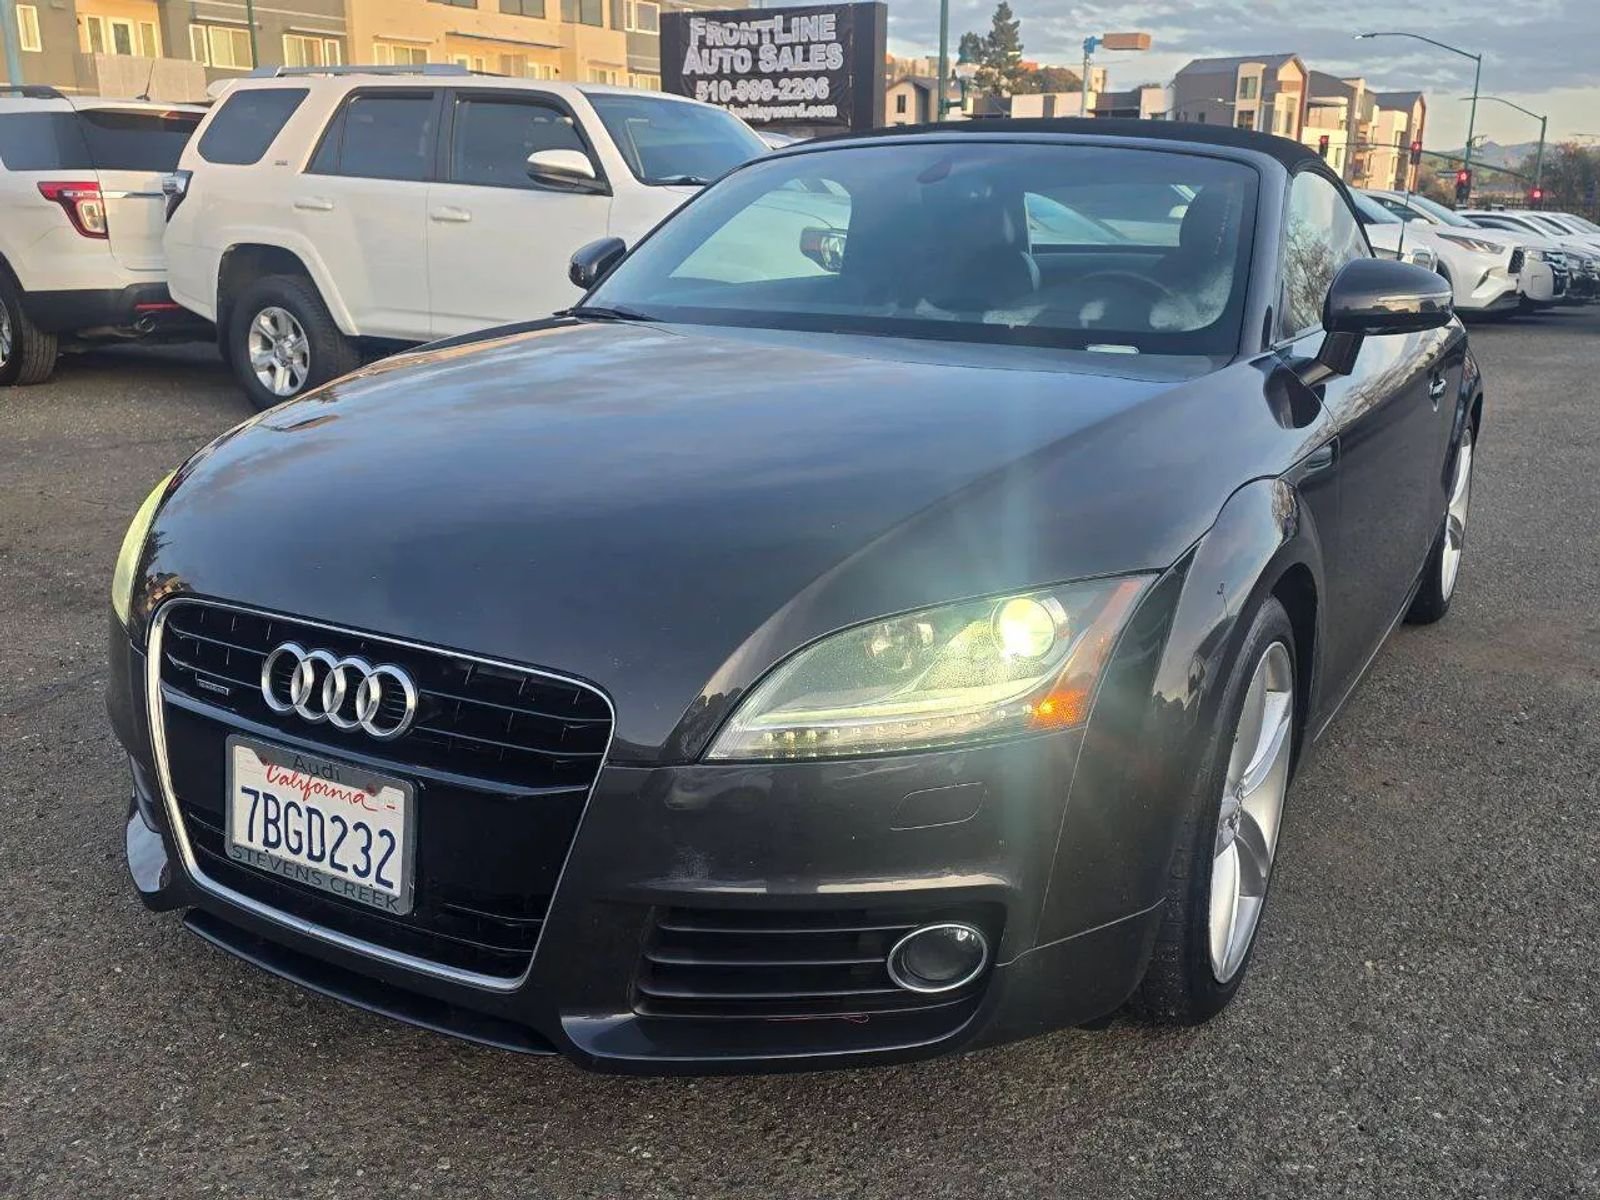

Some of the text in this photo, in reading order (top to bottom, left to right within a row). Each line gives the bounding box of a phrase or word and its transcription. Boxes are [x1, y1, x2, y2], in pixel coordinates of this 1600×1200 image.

[690, 13, 837, 47] FRONTLINE
[682, 42, 844, 75] AUTO SALES
[695, 76, 830, 102] 510-999-2296
[293, 755, 341, 781] Audi
[265, 762, 378, 812] California
[241, 785, 397, 890] 7BGD232
[232, 845, 400, 912] STEVENS CREEK
